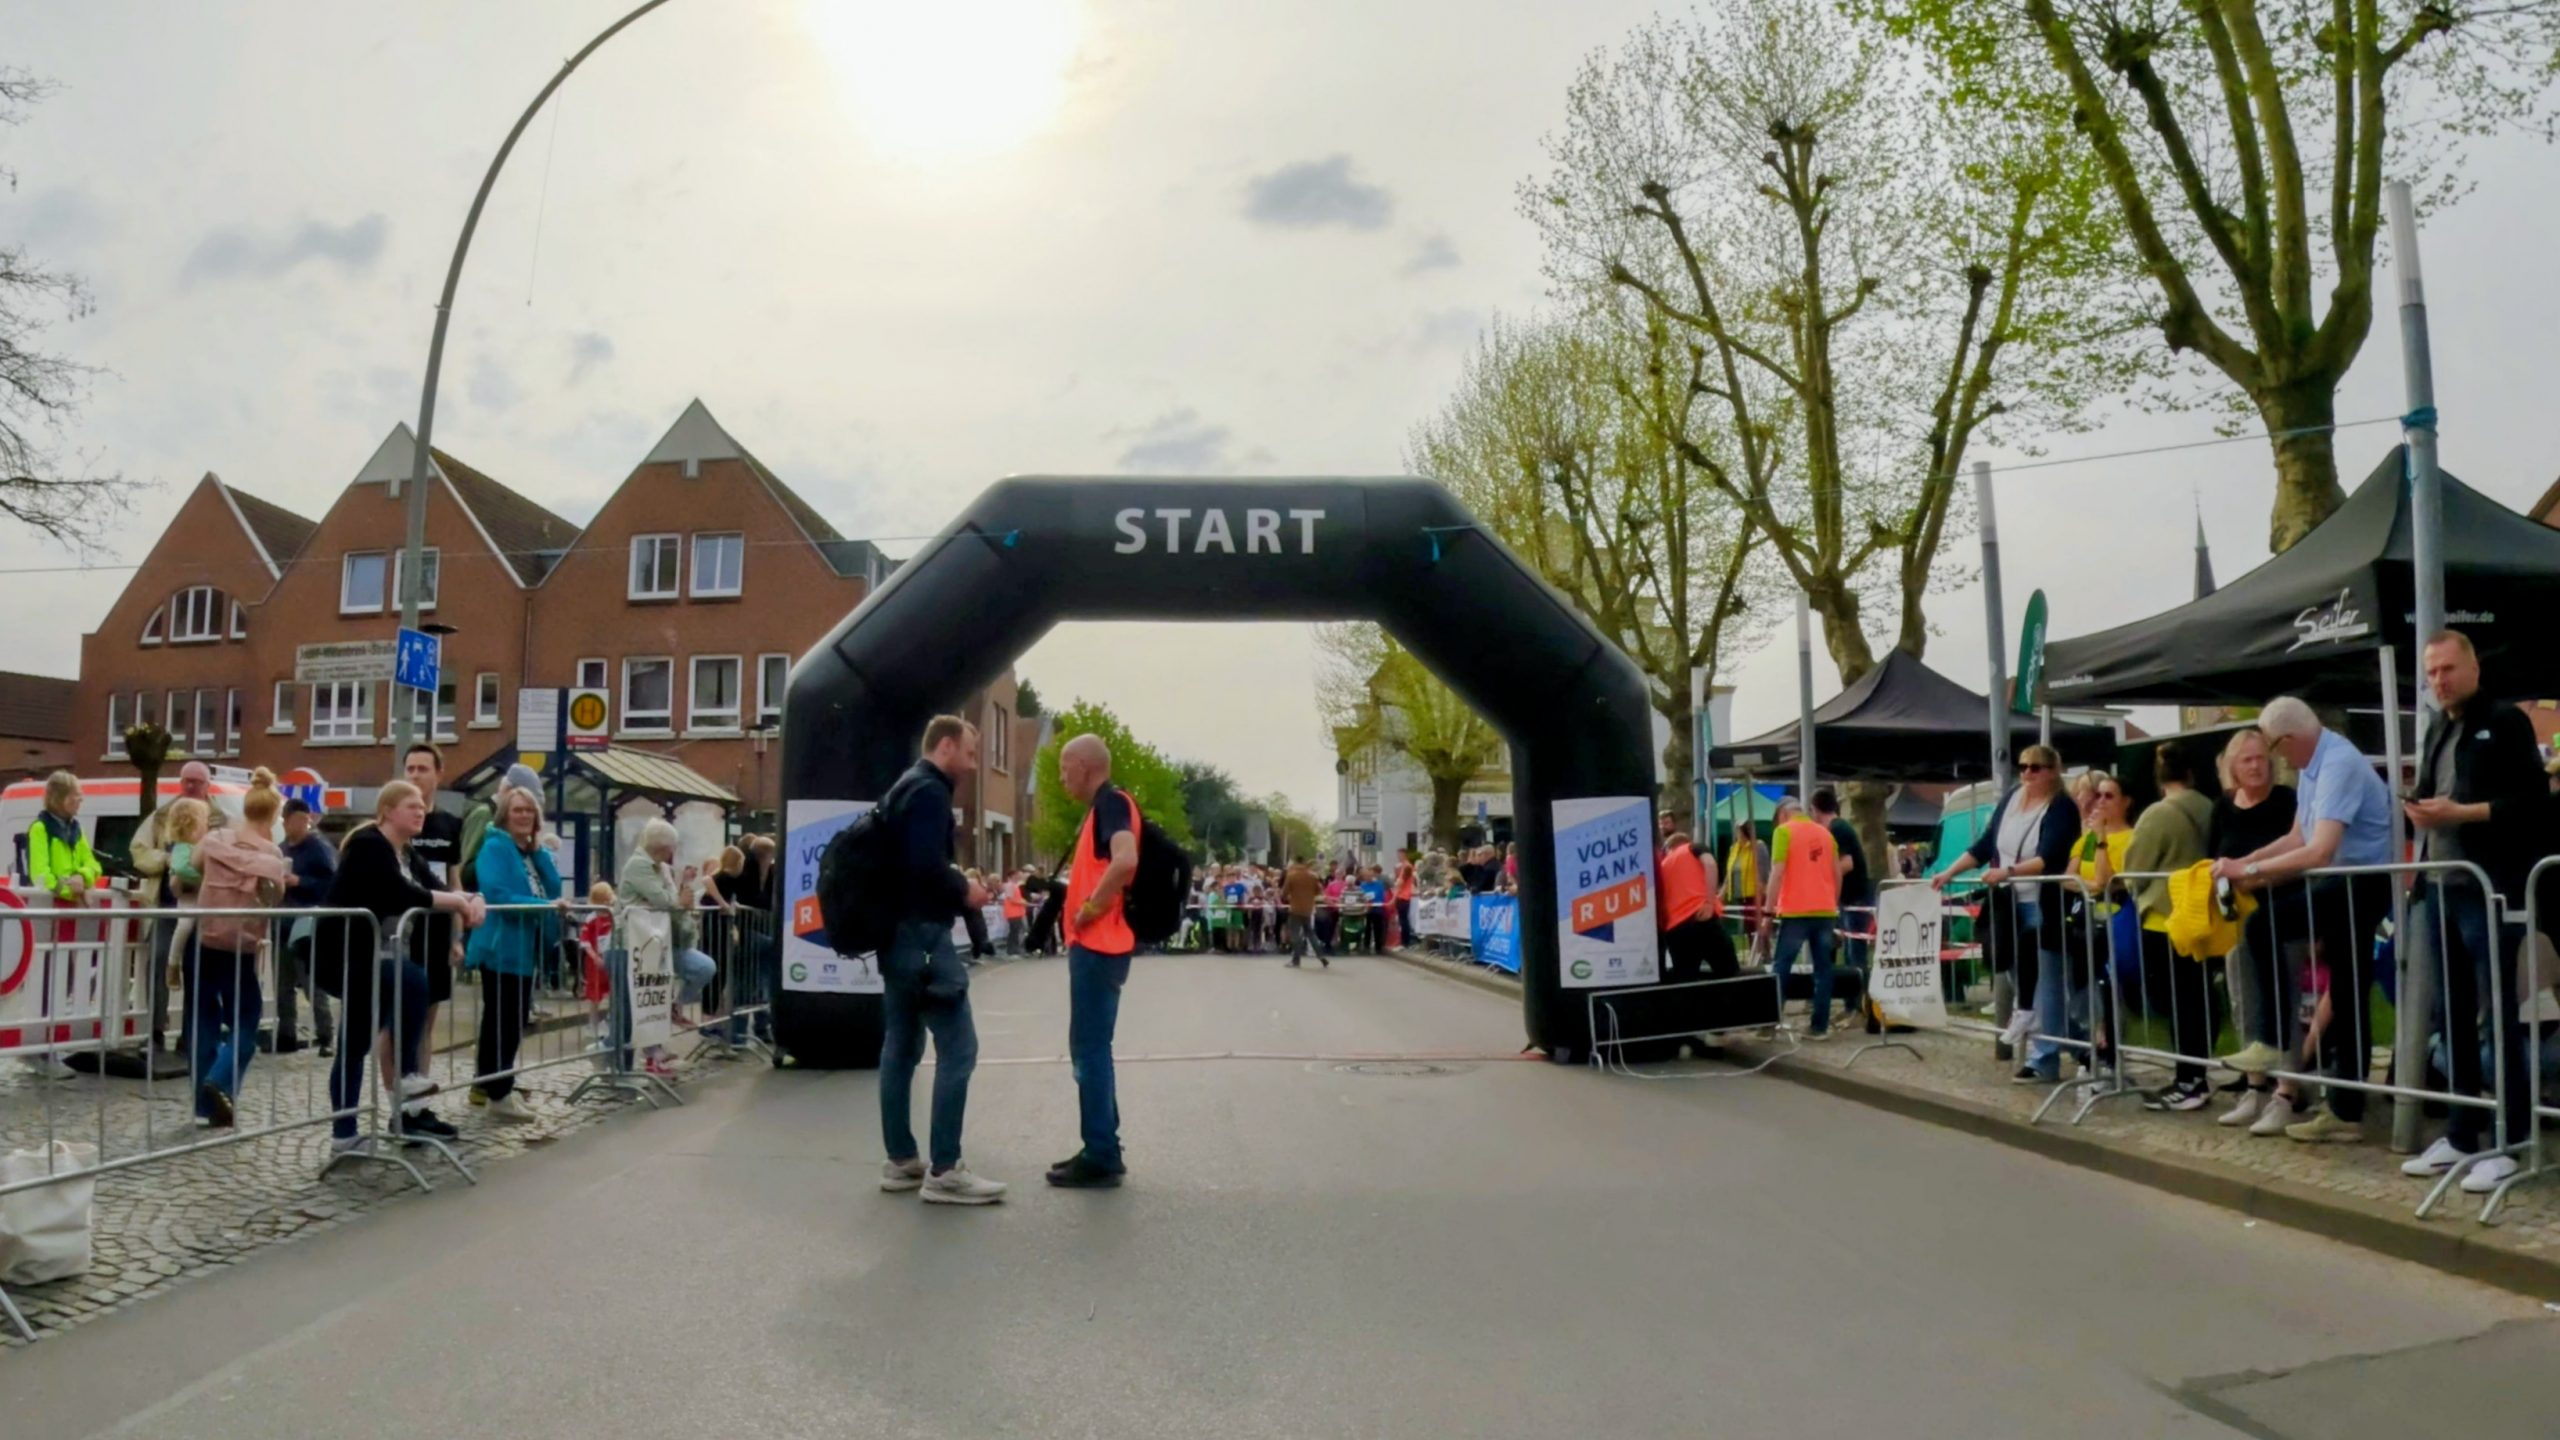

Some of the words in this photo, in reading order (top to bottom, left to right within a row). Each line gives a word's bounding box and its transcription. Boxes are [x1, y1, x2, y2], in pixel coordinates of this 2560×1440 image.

[1113, 507, 1325, 554] START
[581, 702, 595, 721] H
[1577, 828, 1639, 863] VOLKS
[1579, 852, 1640, 889] BANK
[1580, 884, 1642, 922] RUN
